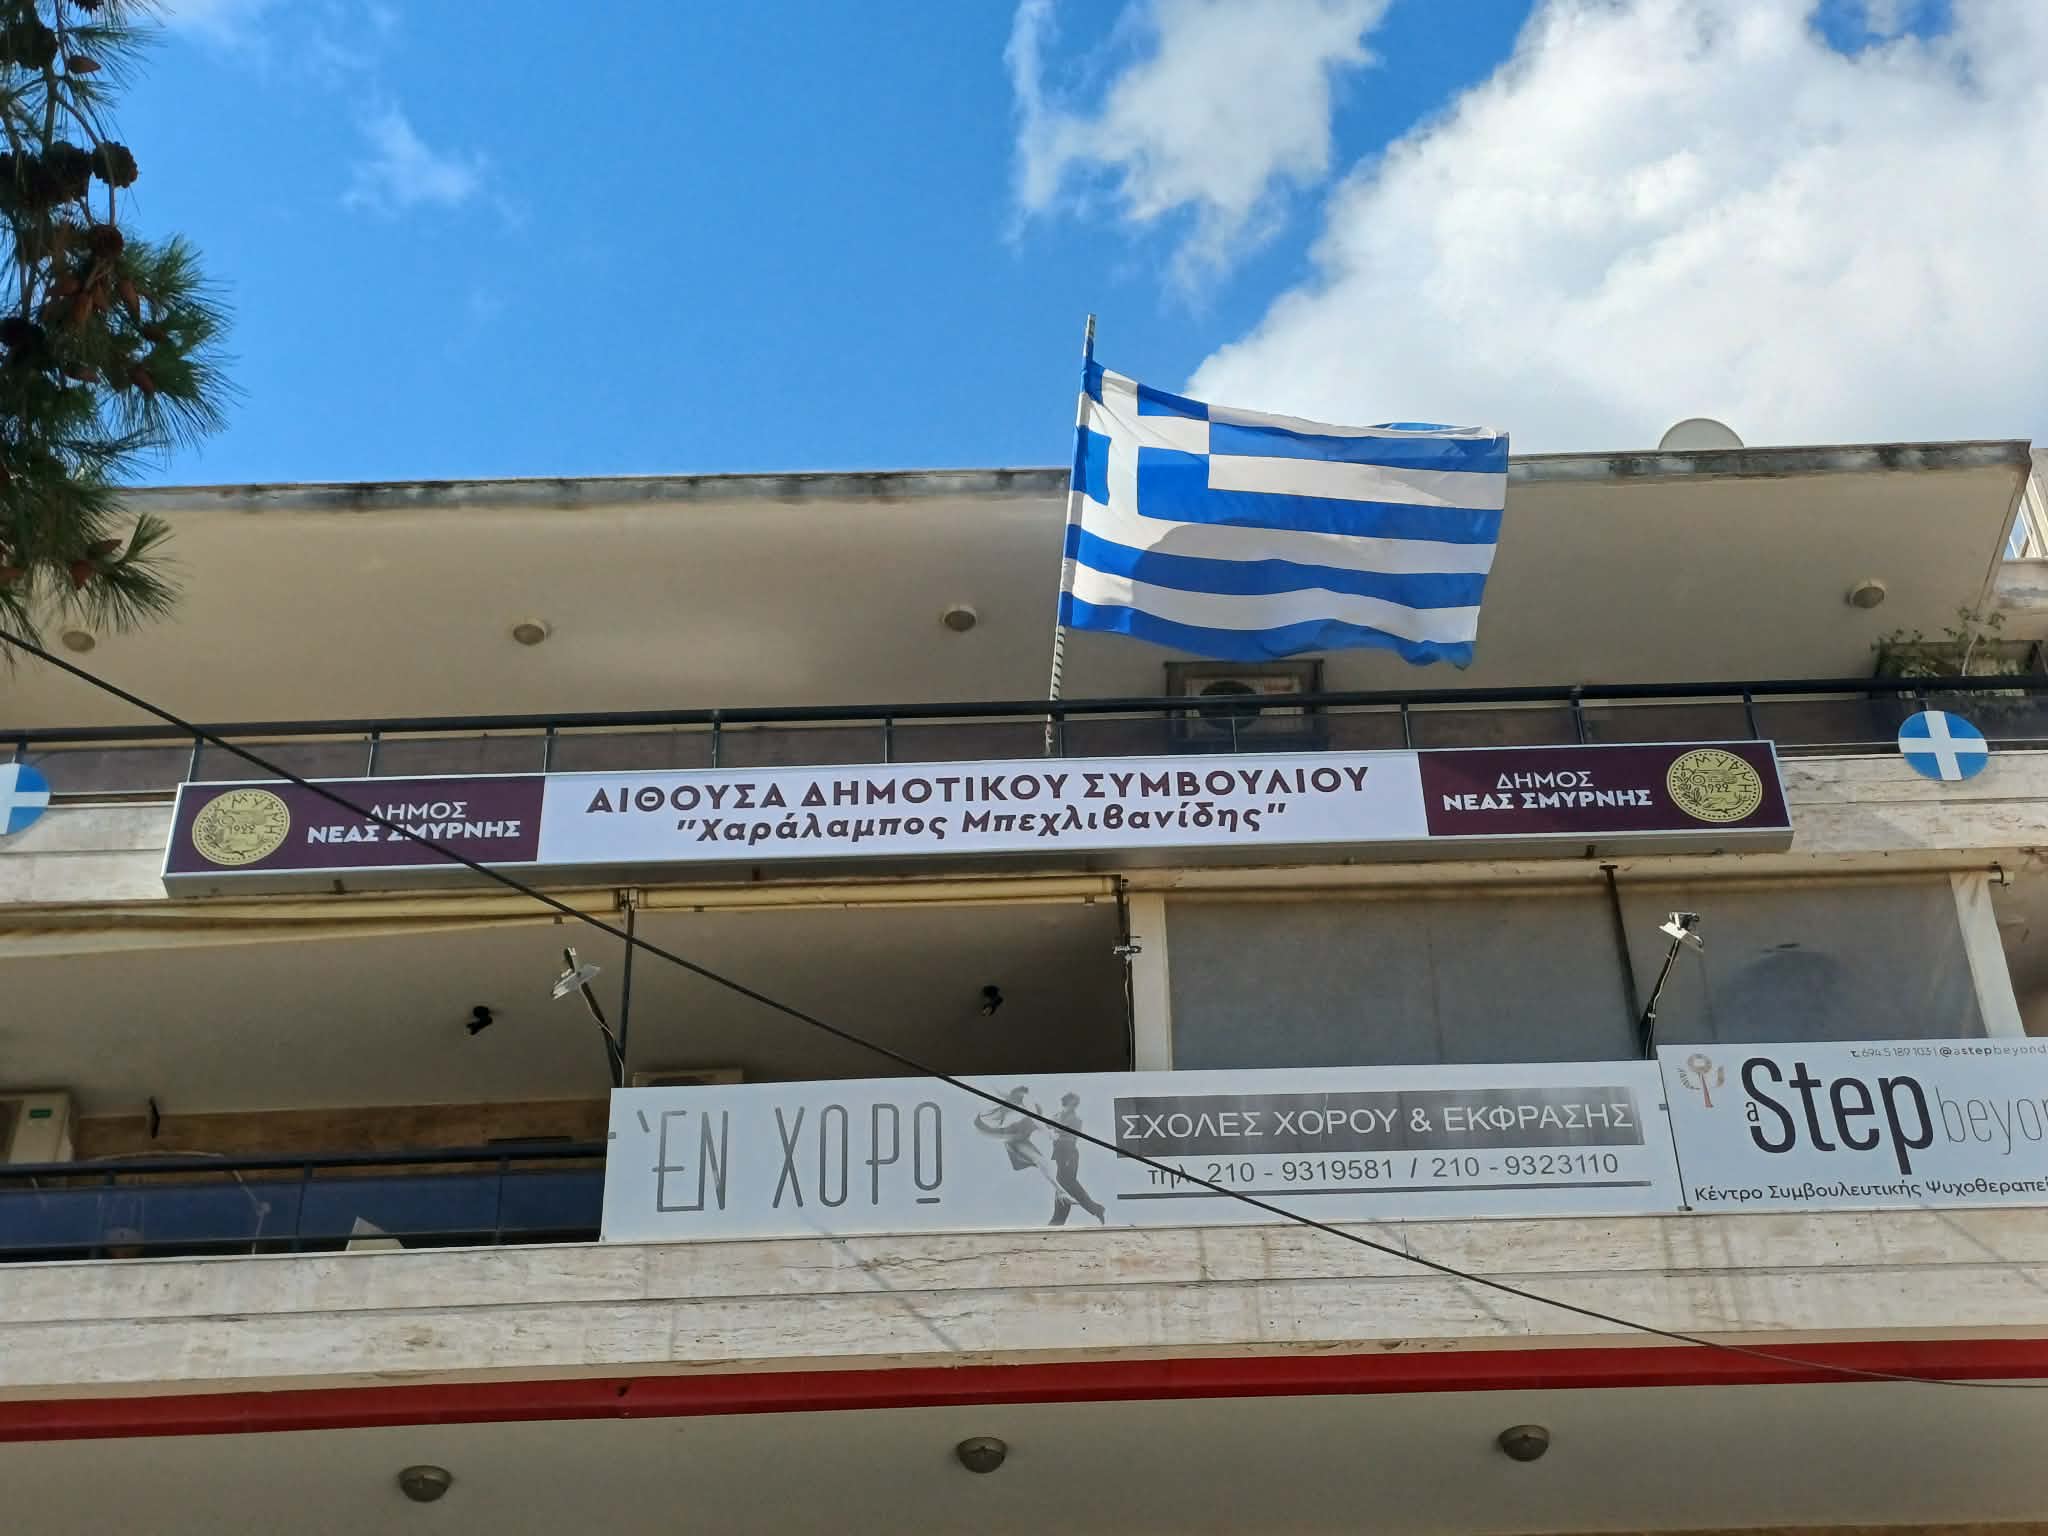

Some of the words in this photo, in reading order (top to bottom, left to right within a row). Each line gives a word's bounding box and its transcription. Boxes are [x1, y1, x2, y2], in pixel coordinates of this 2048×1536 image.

[586, 783, 787, 814] ΑΙΘΟΥΣΑ
[800, 774, 1069, 806] ΔΗΜΟΤΙΚΟΥ
[1083, 766, 1369, 799] ΣΥΜΒΟΥΛΙΟΥ
[1496, 770, 1595, 790] ΔΗΜΟΣ
[366, 801, 468, 821] ΔΗΜΟΣ
[1443, 792, 1514, 811] ΝΕΑΣ
[1521, 789, 1653, 809] ΣΜΥΡΝΗΣ
[307, 825, 380, 844] ΝΕΑΣ
[387, 820, 521, 842] ΣΜΥΡΝΗΣ
[1121, 1112, 1264, 1140] ΣΧΟΛΕΣ
[1274, 1107, 1399, 1136] ΧΟΡΟΥ
[1409, 1107, 1433, 1133] &
[1443, 1102, 1634, 1131] ΕΚΦΡΑΣΗΣ
[1206, 1162, 1255, 1183] 210
[1281, 1159, 1393, 1181] 9319581
[1432, 1156, 1481, 1178] 210
[1505, 1153, 1619, 1175] 9323110
[1694, 1185, 1763, 1202] Κέντρο
[1769, 1180, 1921, 1201] Συμβουλευτικής
